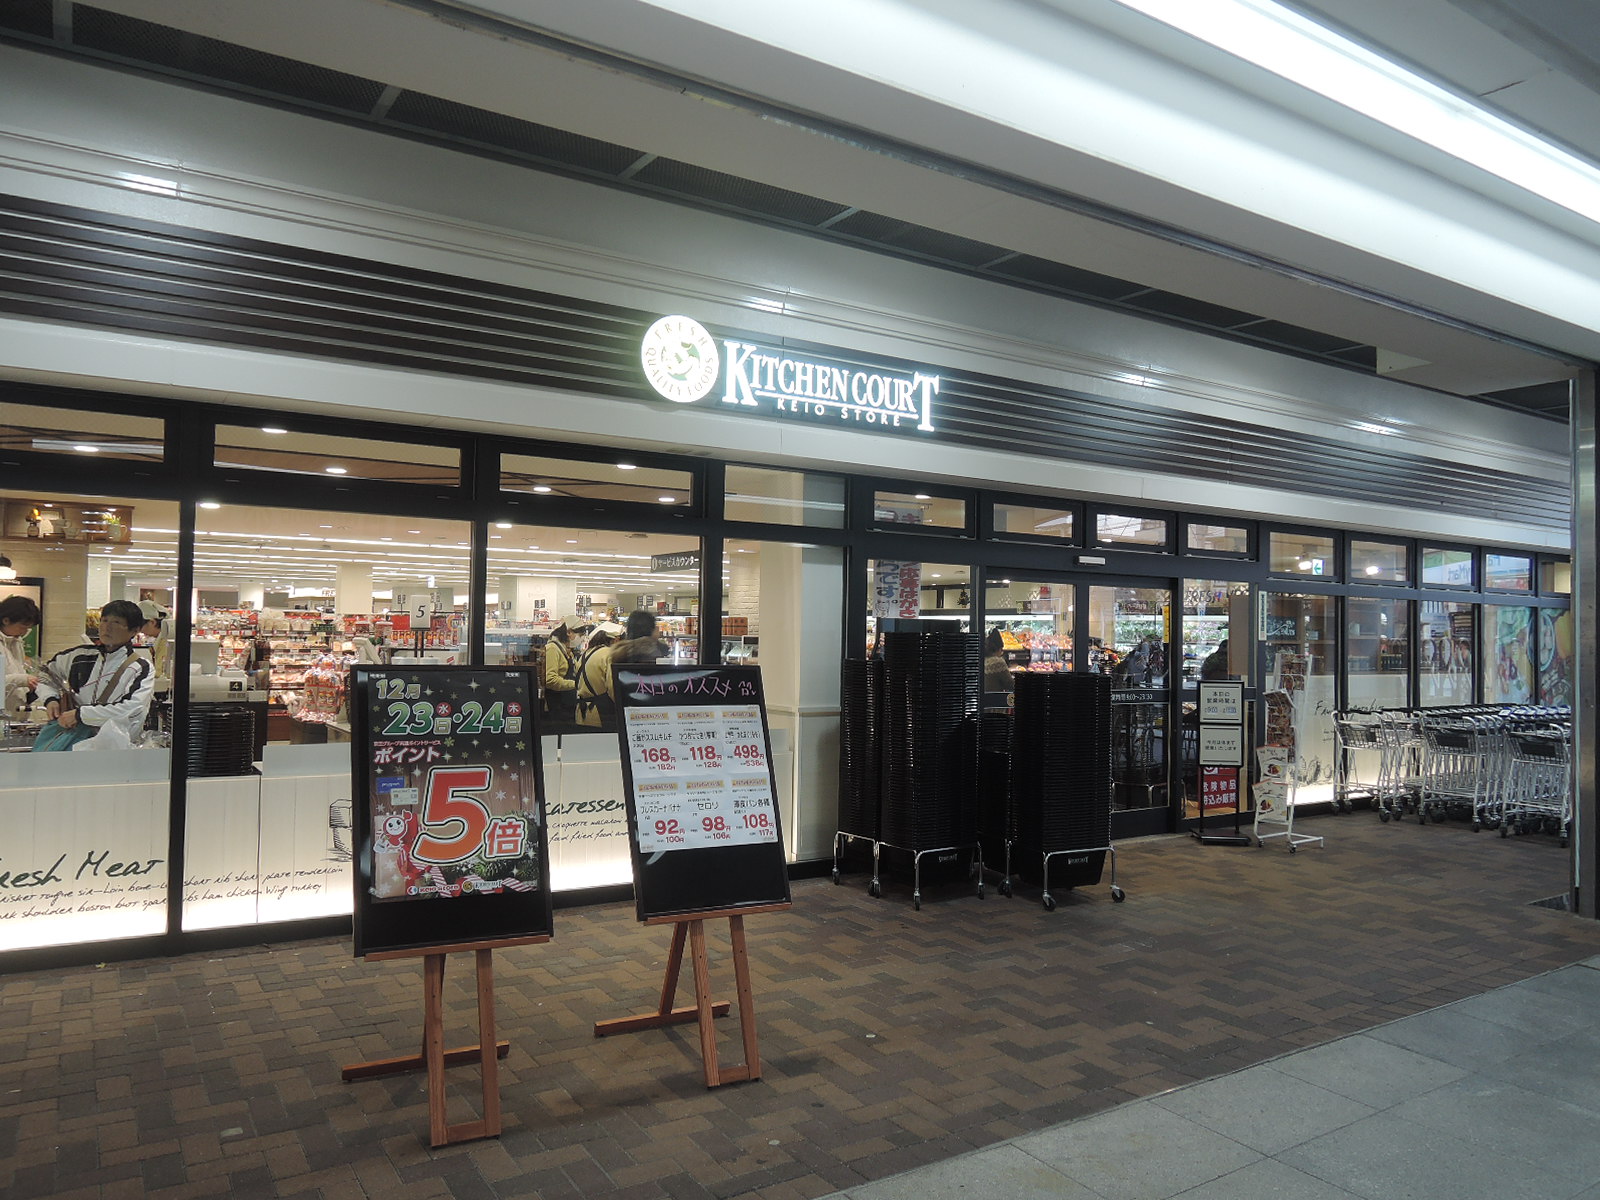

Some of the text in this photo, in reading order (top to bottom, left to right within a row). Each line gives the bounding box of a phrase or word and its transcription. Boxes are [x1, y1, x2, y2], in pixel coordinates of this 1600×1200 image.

[654, 321, 708, 346] FRESH
[721, 340, 940, 432] KITCHEN COURT
[776, 397, 902, 428] KEIO STORE
[415, 604, 427, 618] 5
[376, 678, 421, 700] 12月
[373, 746, 441, 764] ポイント
[75, 850, 165, 881] Meat
